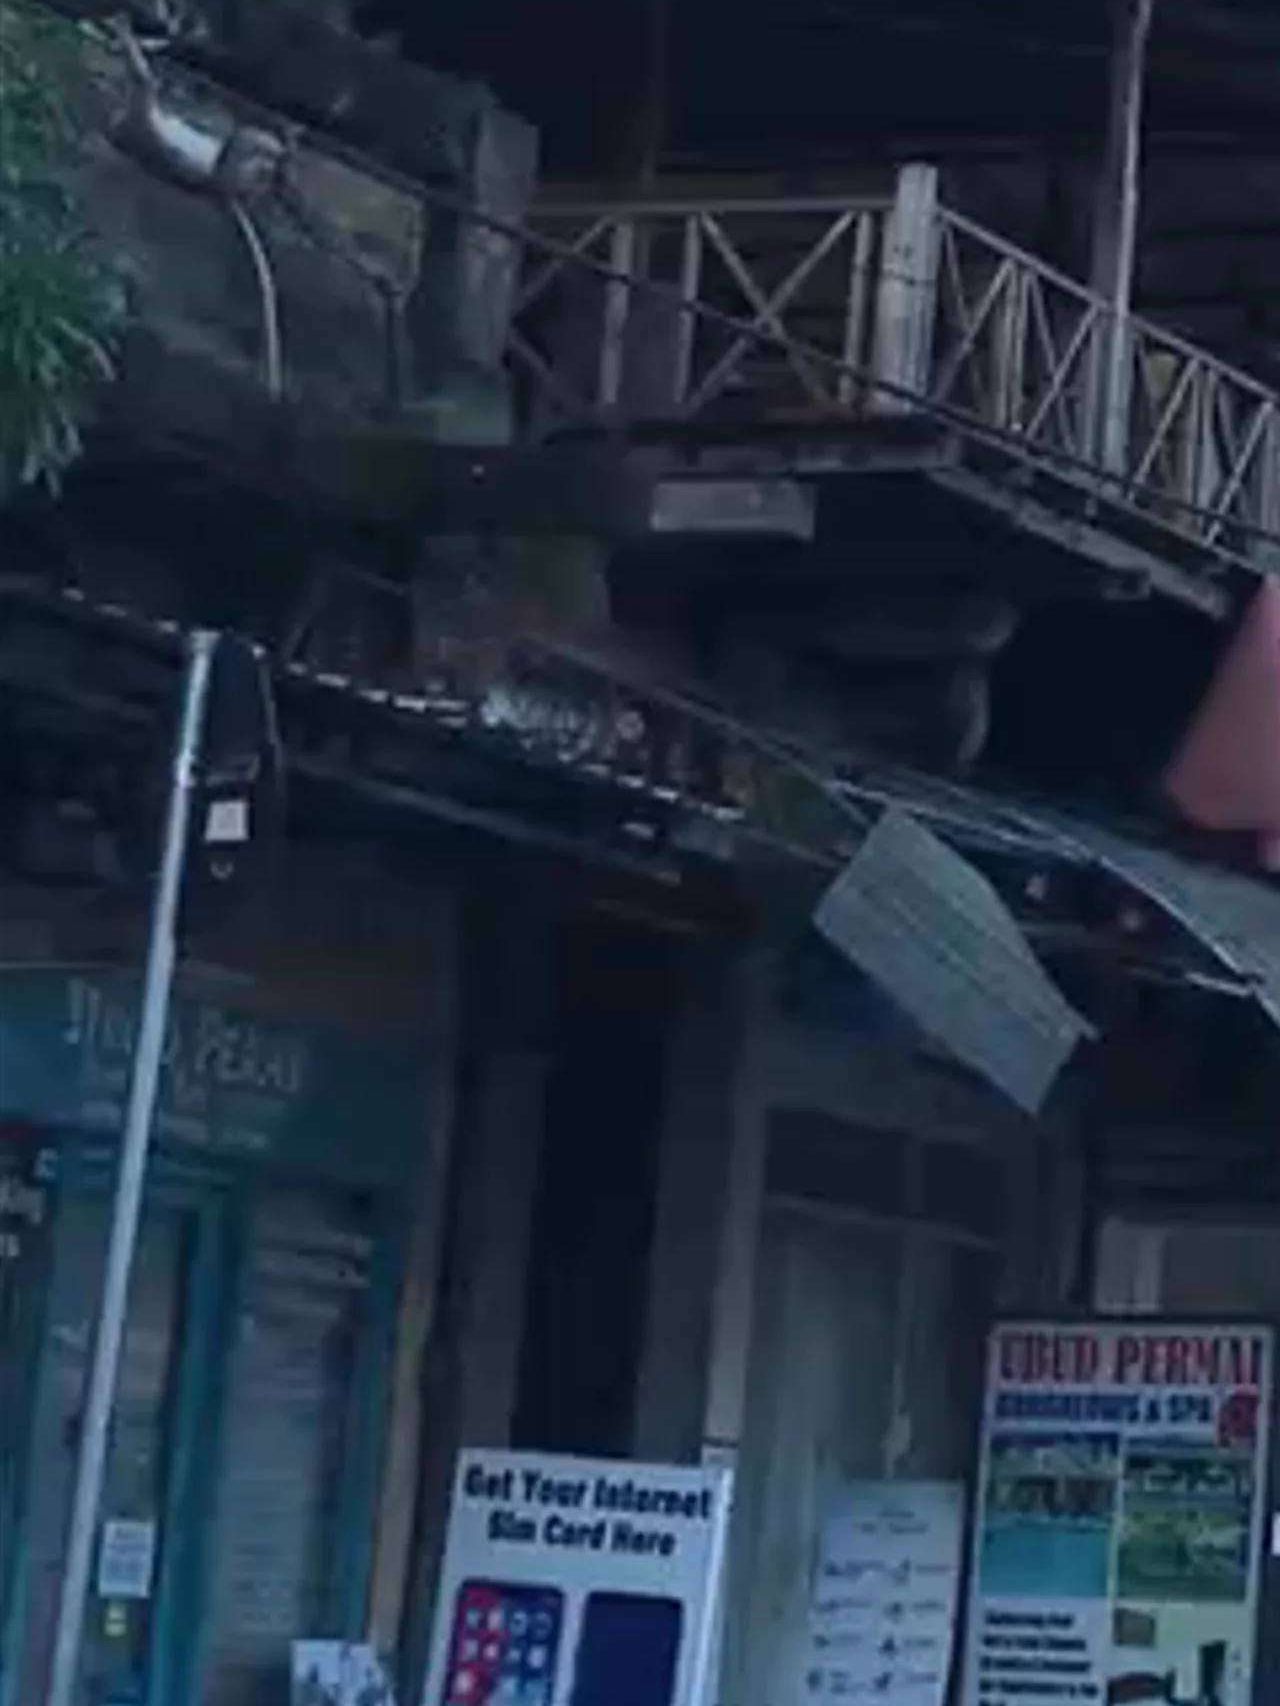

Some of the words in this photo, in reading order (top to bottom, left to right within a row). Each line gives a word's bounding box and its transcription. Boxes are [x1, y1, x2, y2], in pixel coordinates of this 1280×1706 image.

[1116, 1335, 1263, 1386] PERMAI
[464, 1464, 514, 1501] Get
[522, 1469, 586, 1503] Your
[594, 1477, 711, 1519] Internet
[488, 1510, 535, 1540] Sim
[543, 1516, 605, 1549] Card
[610, 1521, 676, 1555] Here
